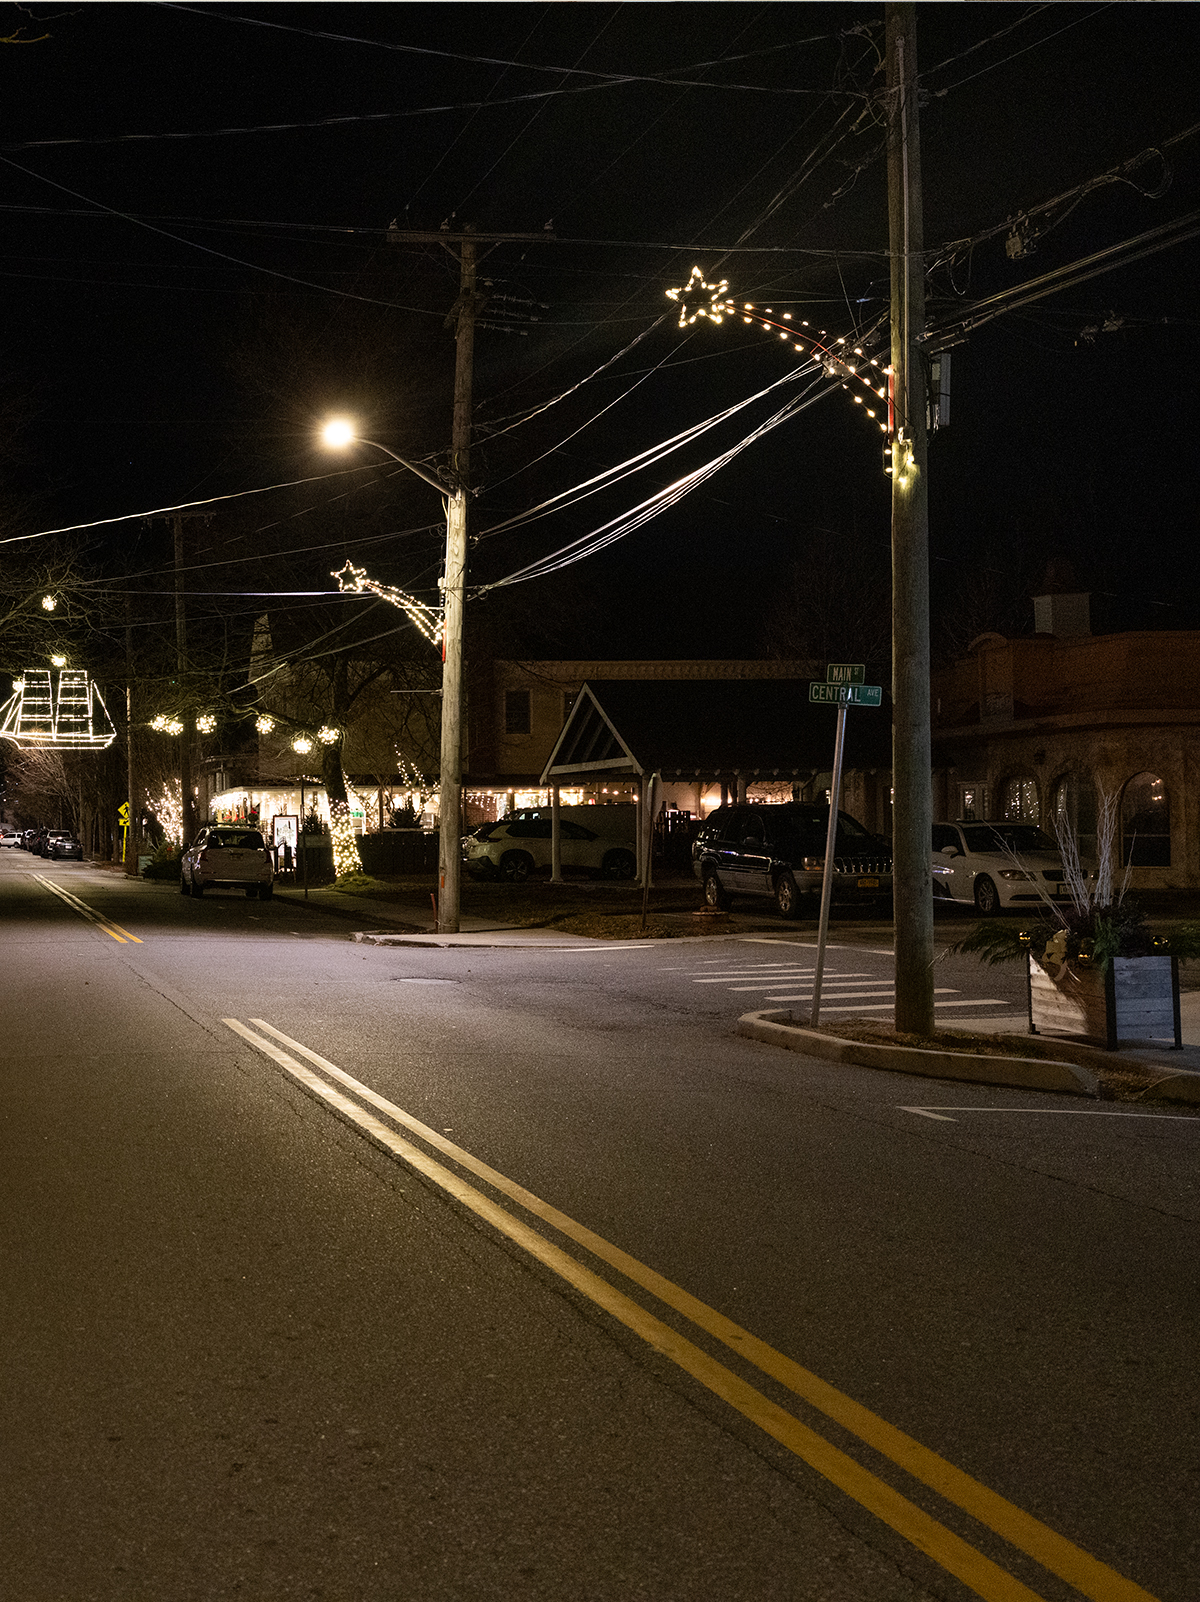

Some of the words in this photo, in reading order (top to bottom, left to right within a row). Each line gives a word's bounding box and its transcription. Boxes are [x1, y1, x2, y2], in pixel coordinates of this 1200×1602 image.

[832, 666, 852, 681] MAIN
[812, 685, 861, 701] CENTRAL
[866, 688, 879, 697] AVE
